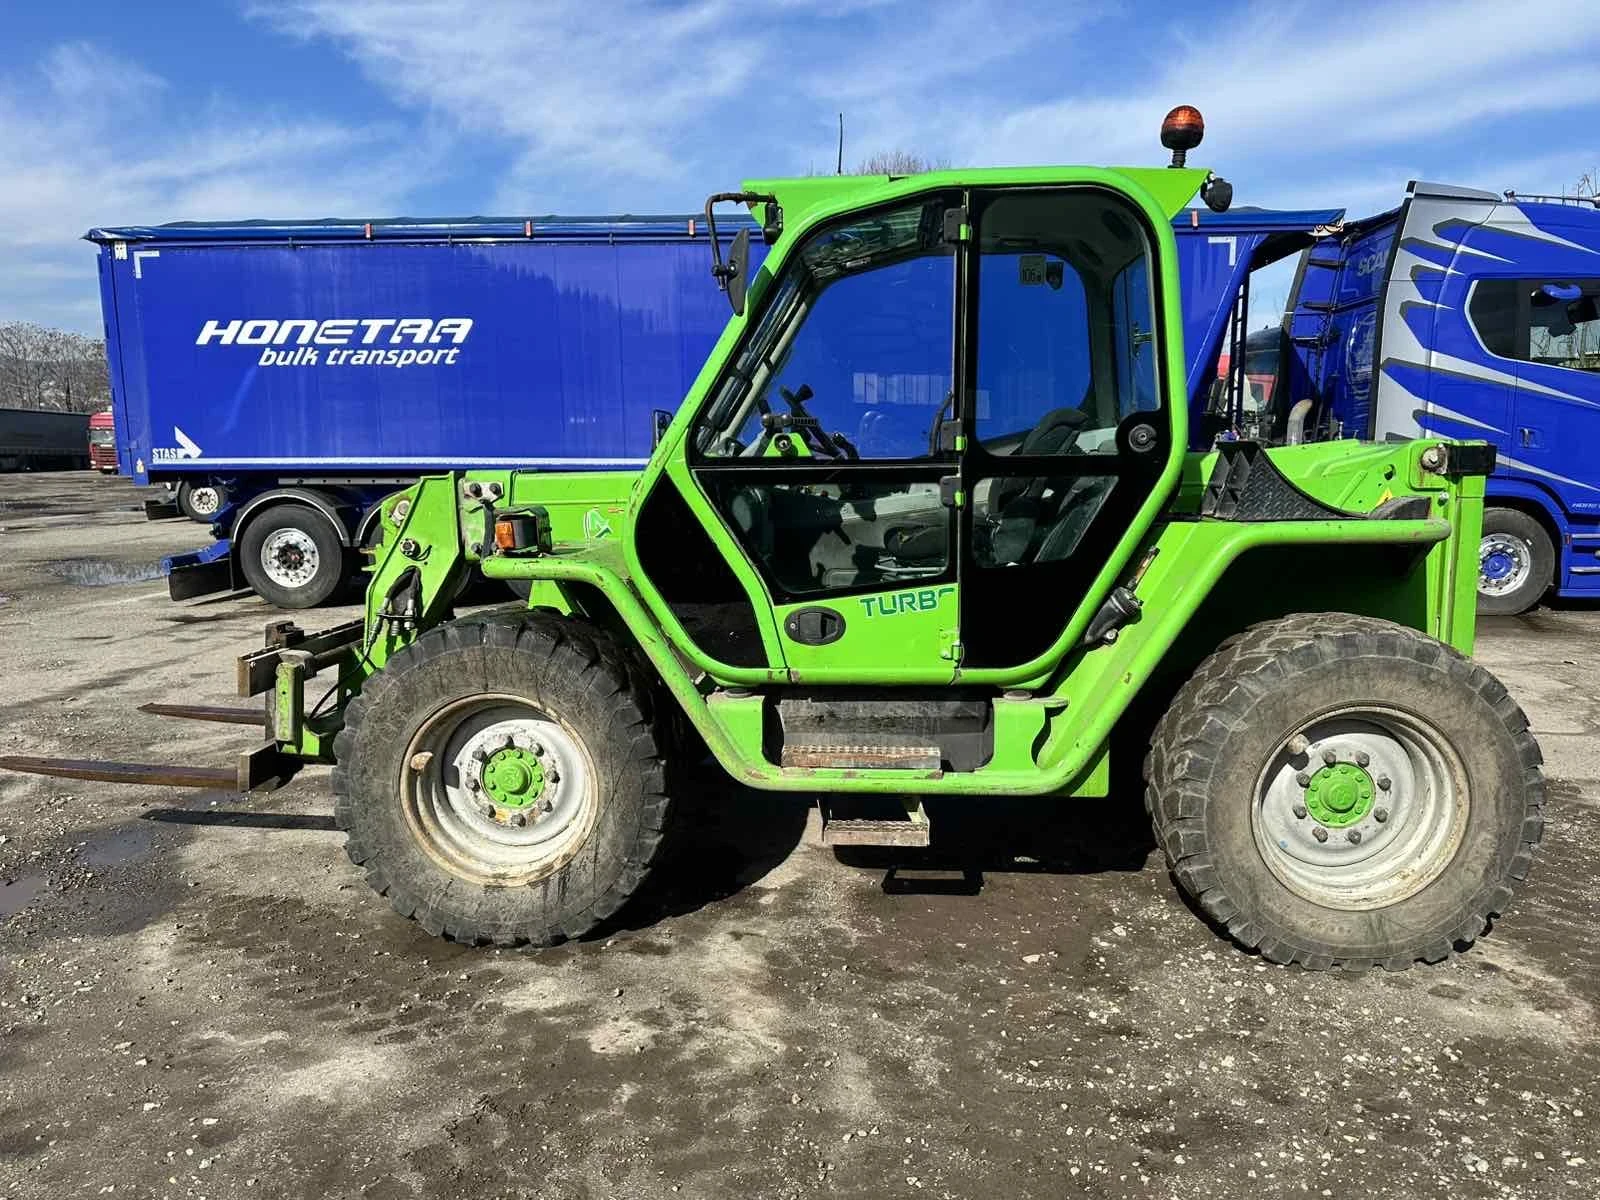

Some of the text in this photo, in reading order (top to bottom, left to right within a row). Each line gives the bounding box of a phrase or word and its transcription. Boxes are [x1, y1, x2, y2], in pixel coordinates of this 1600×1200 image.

[258, 346, 460, 369] bulk transport
[152, 447, 177, 459] STAS
